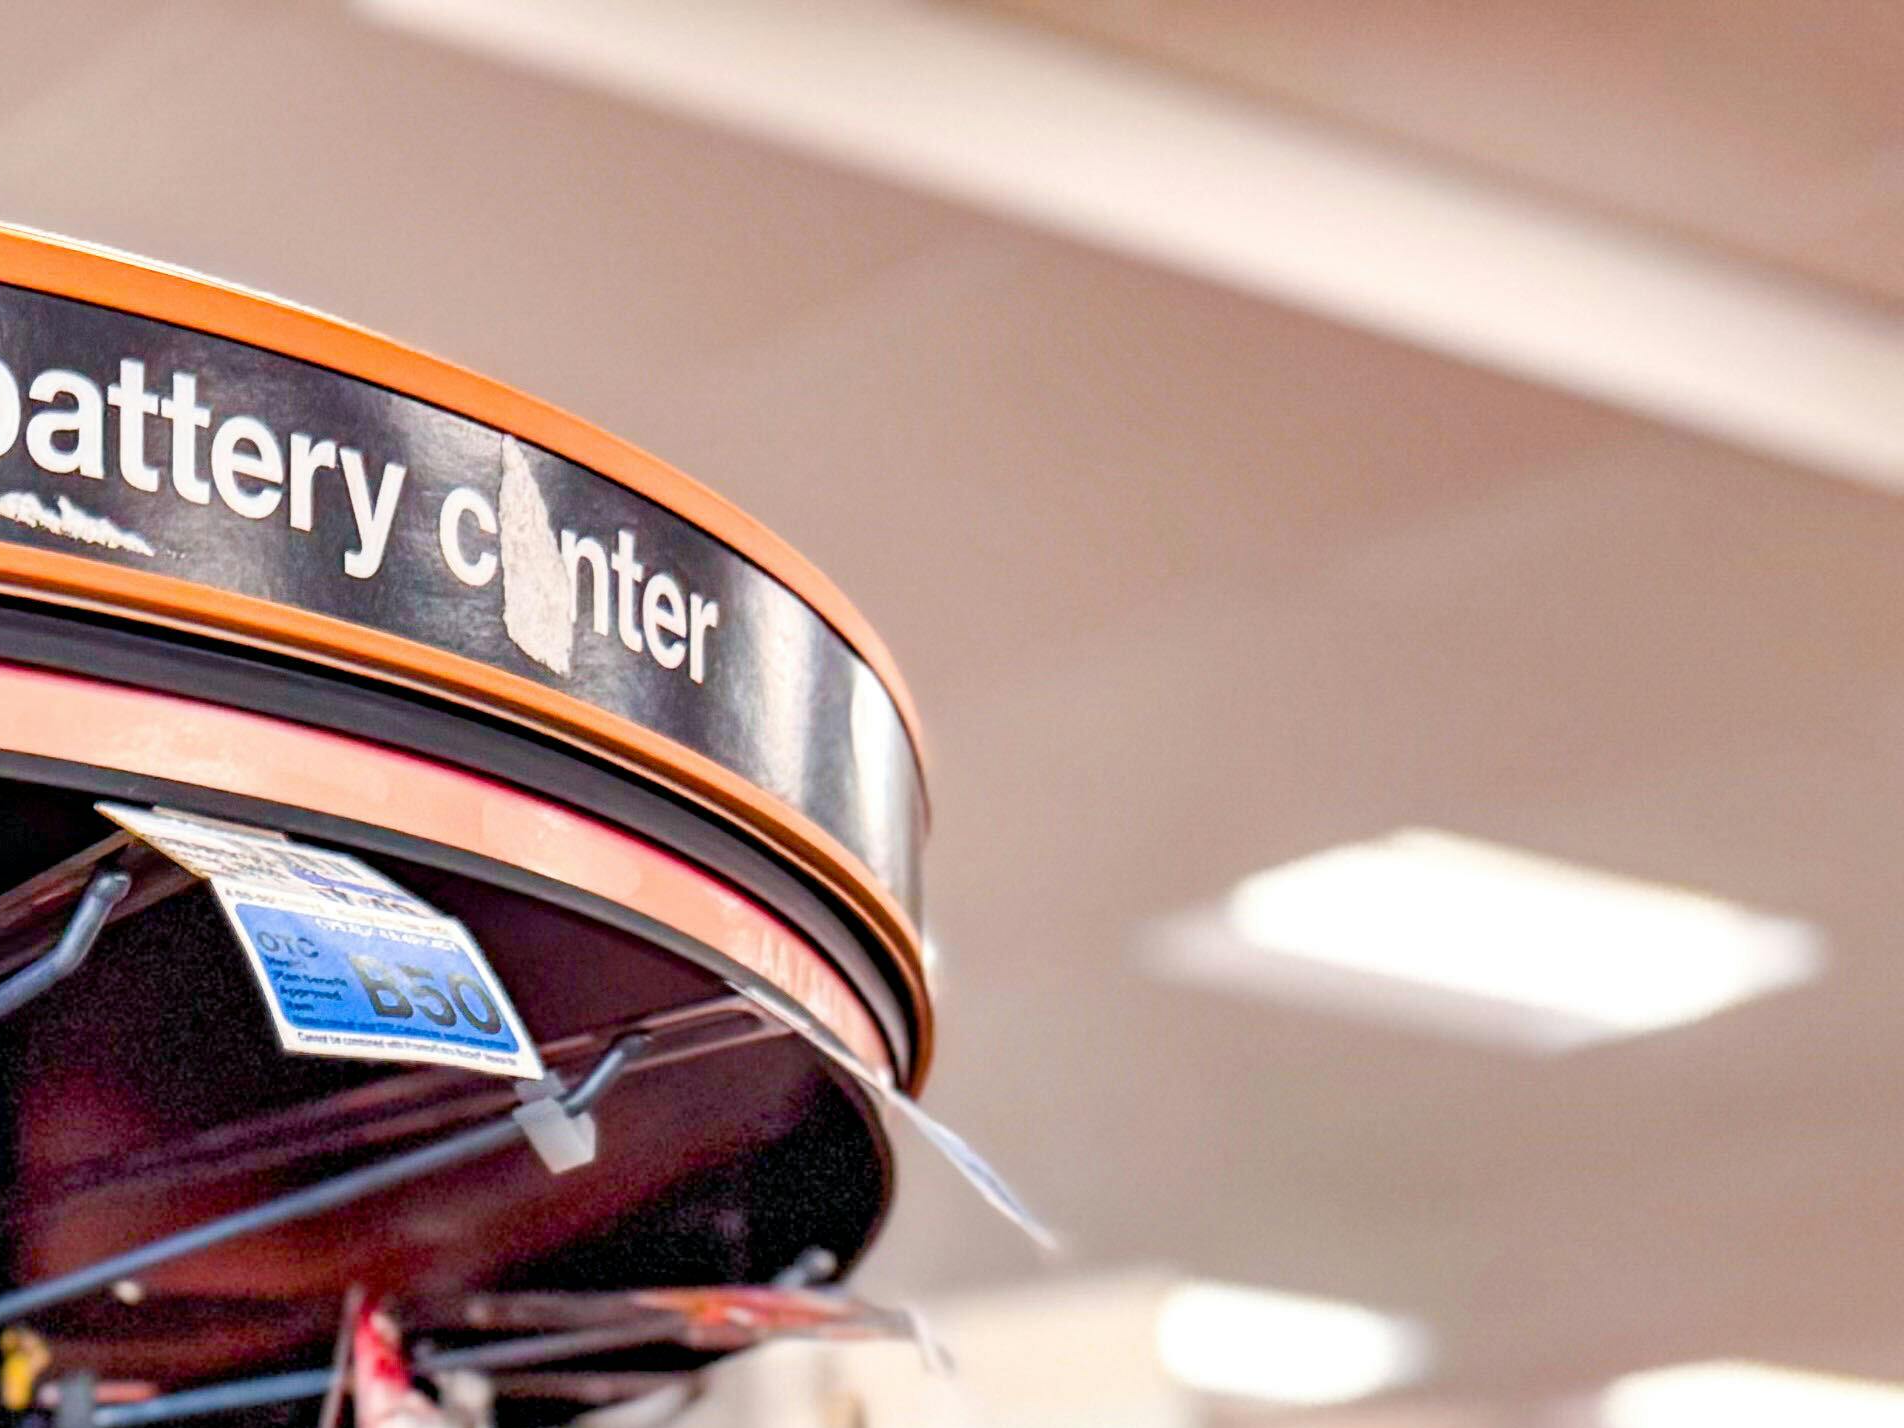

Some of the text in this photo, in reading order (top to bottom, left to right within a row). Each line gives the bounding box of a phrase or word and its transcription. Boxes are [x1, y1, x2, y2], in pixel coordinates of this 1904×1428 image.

[440, 487, 718, 684] cnter
[256, 932, 319, 959] OTC
[348, 954, 502, 1034] B50
